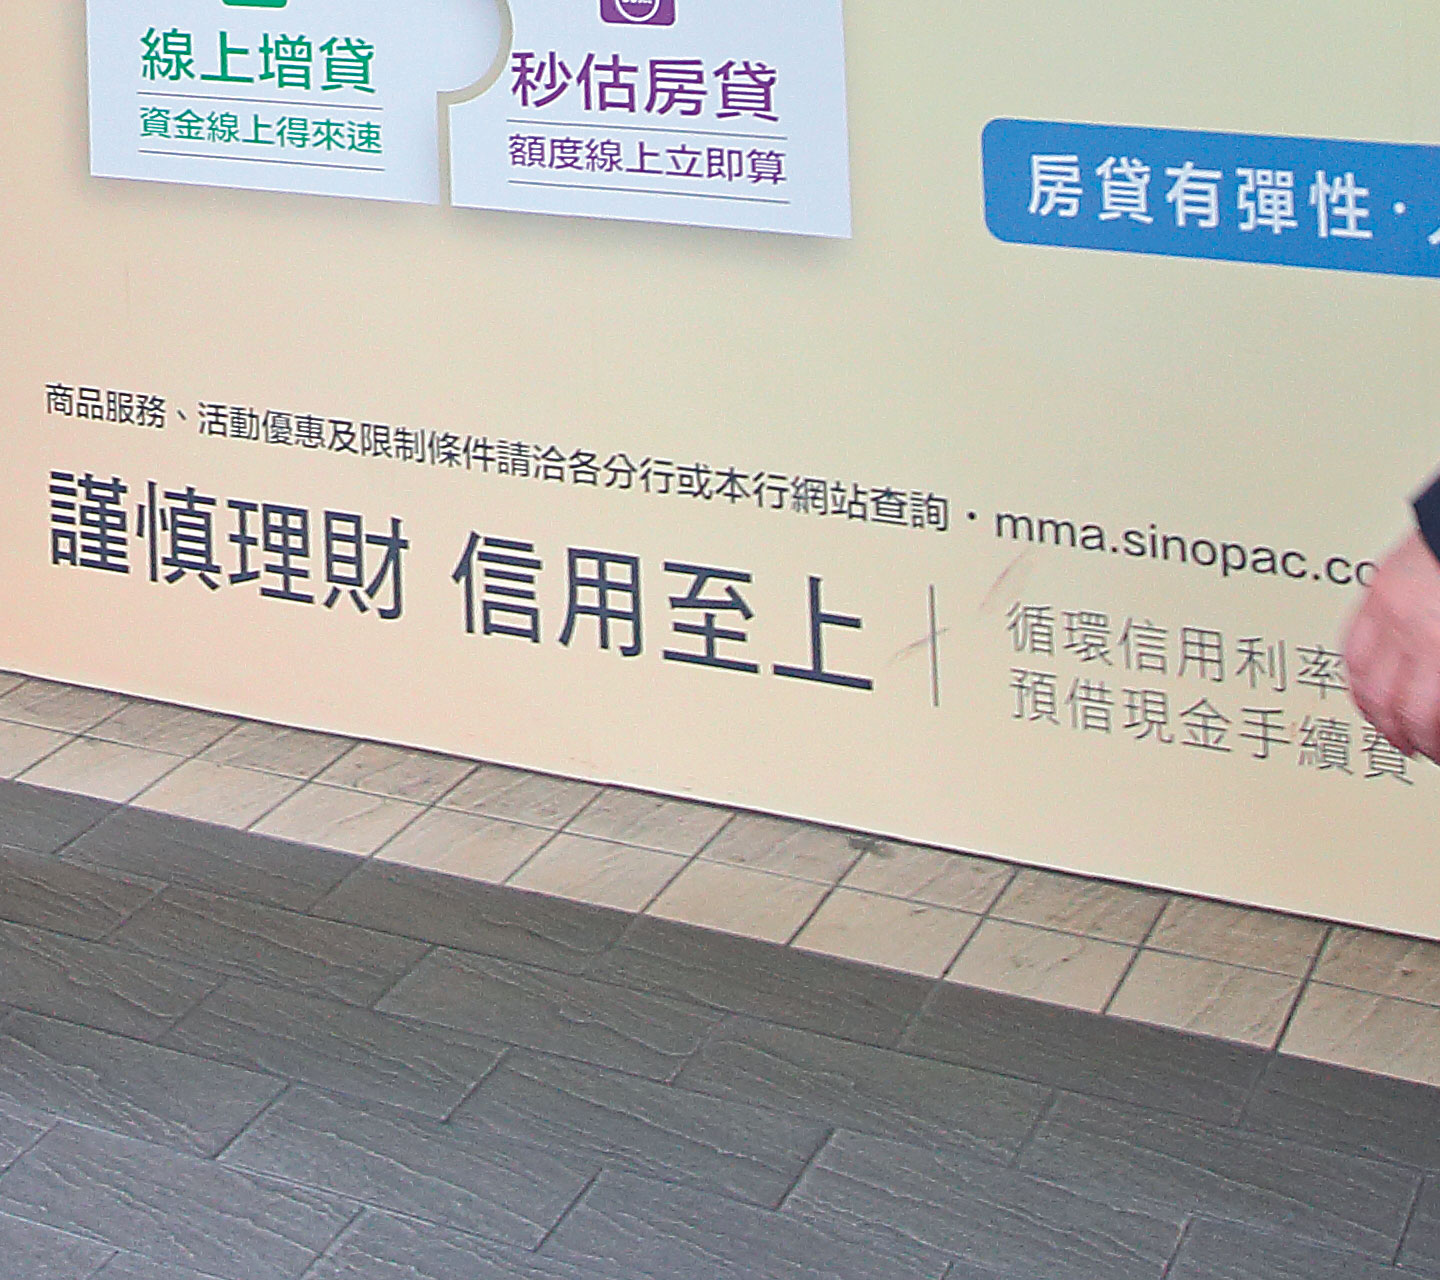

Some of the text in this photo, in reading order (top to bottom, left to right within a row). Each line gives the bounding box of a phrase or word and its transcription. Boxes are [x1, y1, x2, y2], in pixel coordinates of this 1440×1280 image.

[139, 26, 378, 95] 線上增貸
[509, 51, 781, 124] 秒估房貸
[138, 106, 384, 154] 資金線上得來速
[507, 133, 788, 186] 額度線上立即算
[49, 469, 876, 693] 謹慎理財 信用至上
[1006, 600, 1349, 701] 循環信用利率
